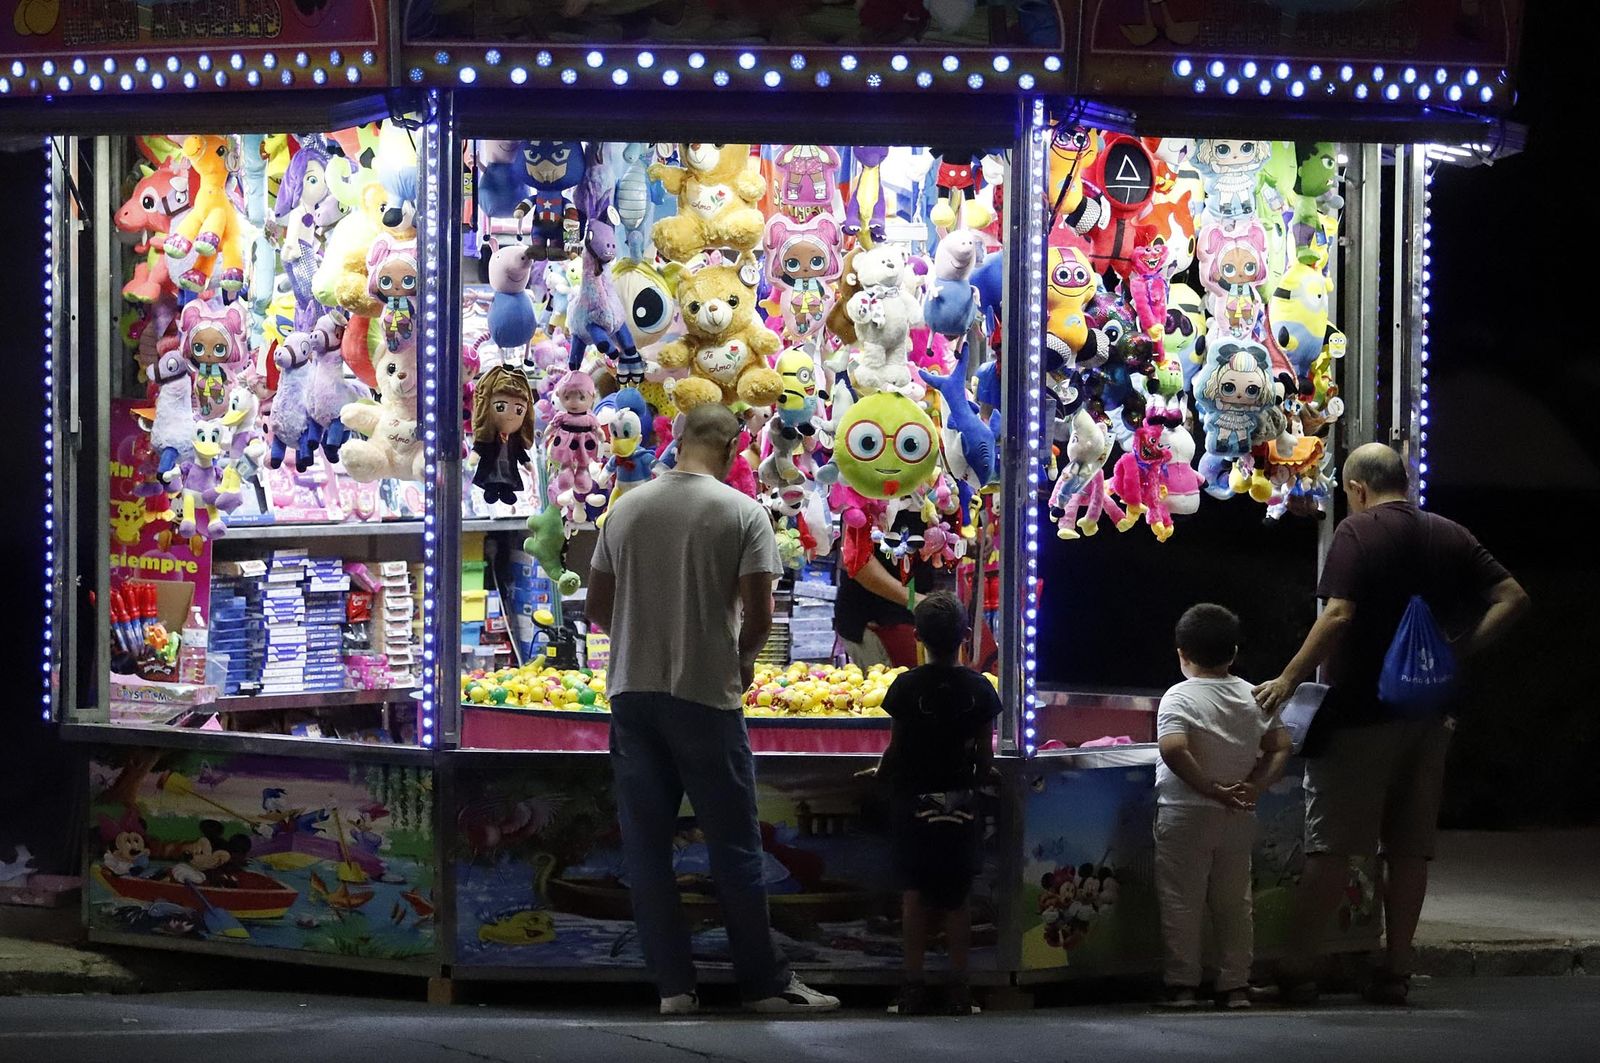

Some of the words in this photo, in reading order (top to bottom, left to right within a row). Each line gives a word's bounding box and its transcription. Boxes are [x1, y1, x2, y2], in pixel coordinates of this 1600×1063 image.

[691, 201, 711, 211] Amo
[703, 350, 714, 361] Te
[708, 363, 731, 373] Amo
[387, 433, 410, 444] Amo
[110, 551, 198, 574] siempre
